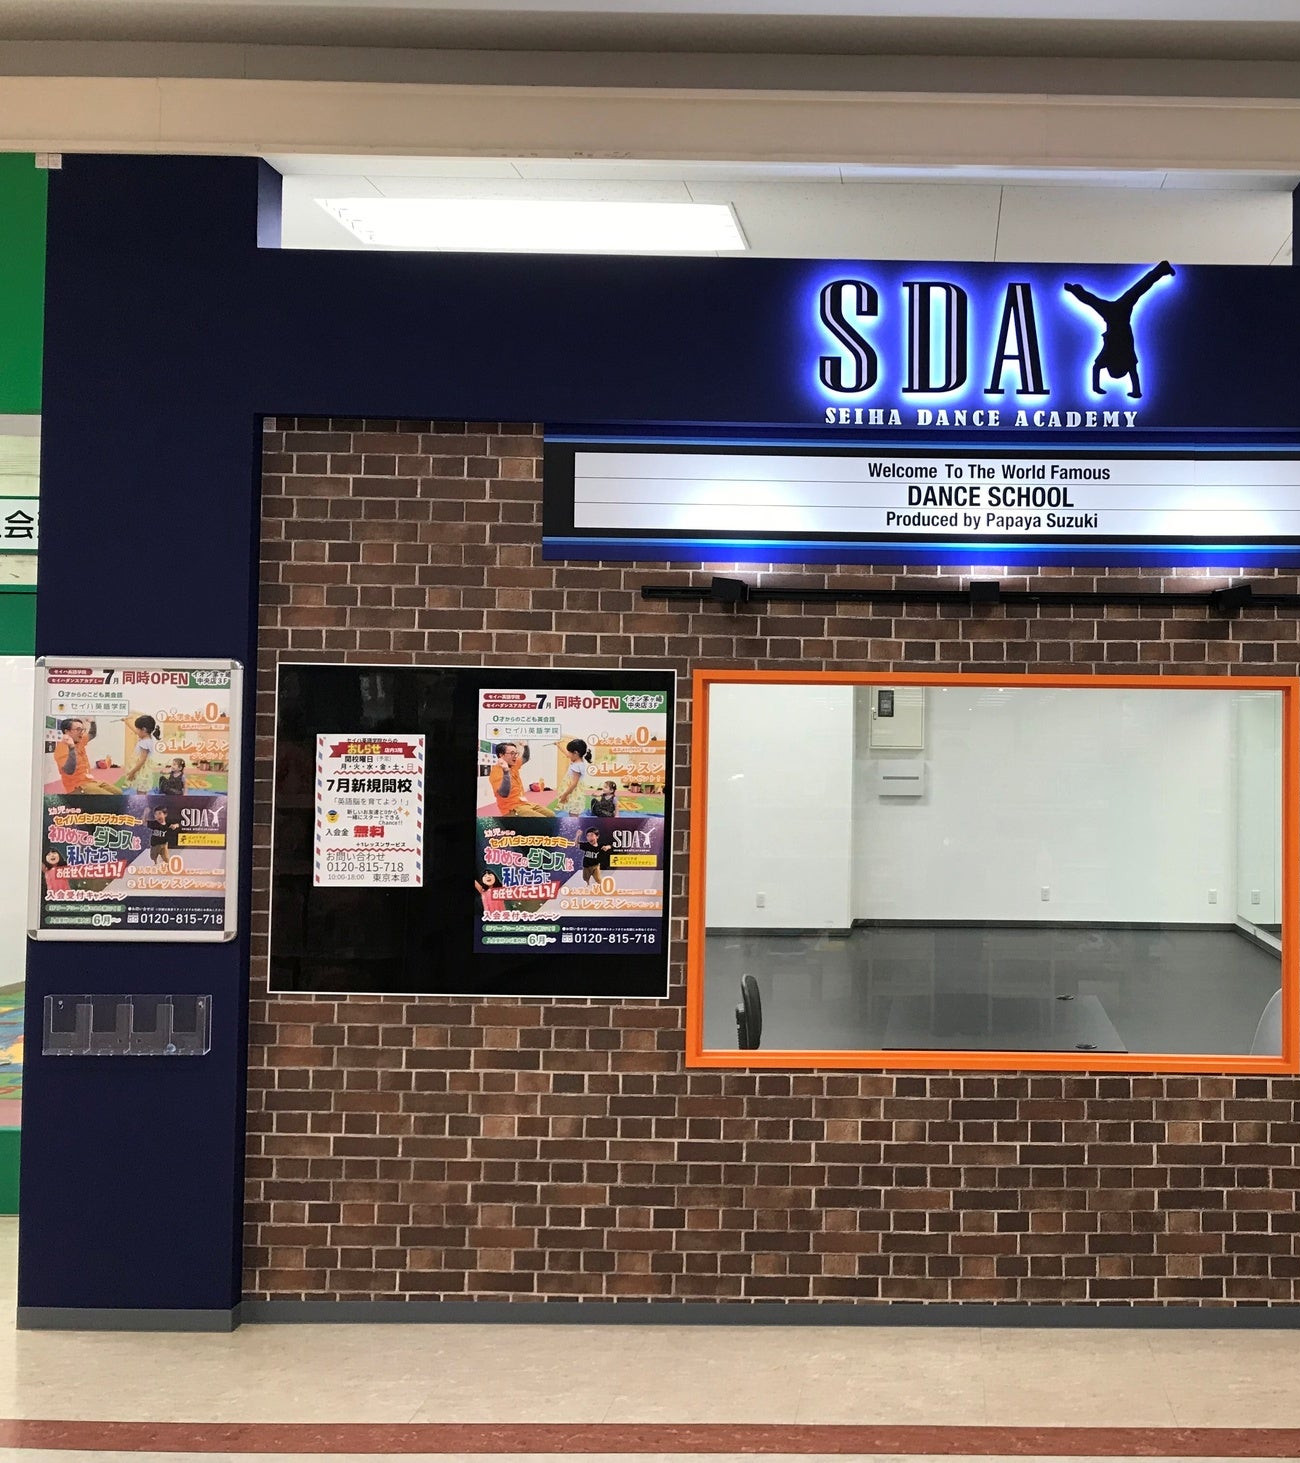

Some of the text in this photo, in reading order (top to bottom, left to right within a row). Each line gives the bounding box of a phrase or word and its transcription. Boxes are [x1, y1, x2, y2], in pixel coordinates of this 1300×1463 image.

[825, 407, 1138, 428] SEIHA DANCE ACADEMY
[868, 462, 1110, 480] Welcome To The World Famous
[907, 485, 1075, 508] DANCE SCHOOL
[886, 511, 1098, 530] Produced by Papaya Suzuki
[102, 669, 188, 685] 7月 同時OPEN
[536, 694, 620, 710] 7月 同時OPEN
[347, 744, 381, 754] おしらせ
[326, 778, 412, 793] 7月新規開校
[54, 813, 142, 826] セイハダンスアカデミー
[325, 825, 385, 838] 入会金 無料
[489, 835, 575, 849] セイハダンスアカデミー
[66, 845, 118, 865] 私たちに
[326, 852, 385, 862] お問い合わせ
[326, 862, 404, 872] 0120-815-718
[373, 873, 410, 883] 東京本部
[502, 868, 551, 888] 私たちに
[140, 914, 223, 924] 0120-815-718
[574, 934, 656, 944] 0120-815-718
